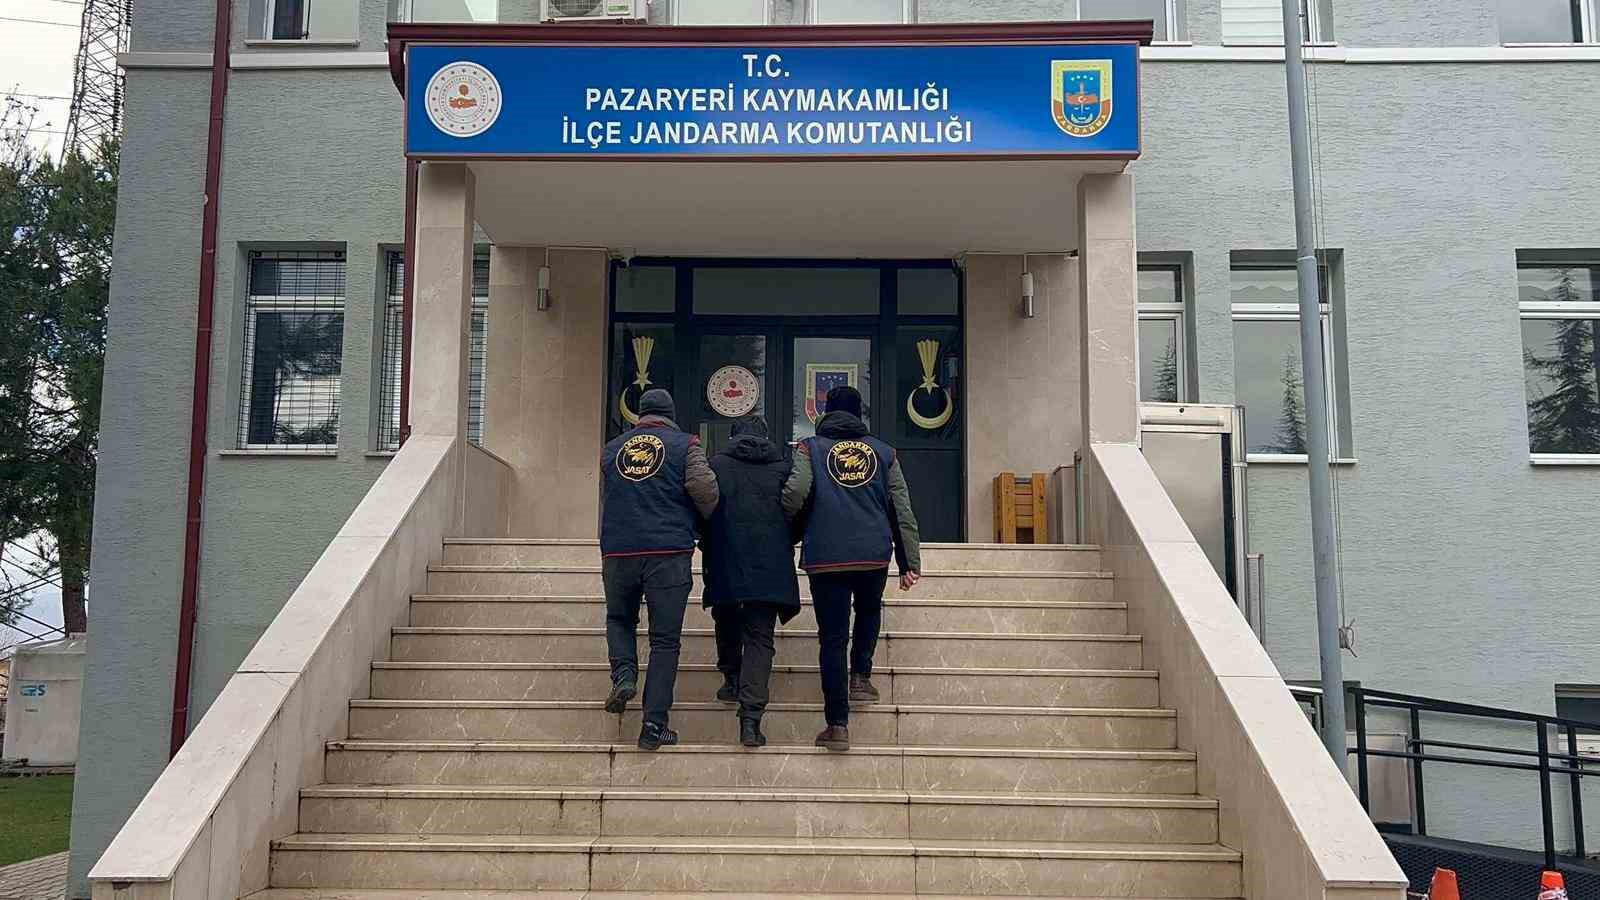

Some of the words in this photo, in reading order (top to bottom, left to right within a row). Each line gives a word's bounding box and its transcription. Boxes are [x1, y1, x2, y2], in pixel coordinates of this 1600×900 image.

[743, 54, 790, 77] T.C.
[586, 83, 733, 111] PAZARYERİ
[743, 82, 948, 111] KAYMAKAMLIĞI
[563, 116, 620, 148] İLÇE
[630, 122, 779, 144] JANDARMA
[787, 115, 972, 143] KOMUTANLIĞI
[624, 435, 663, 451] JANDARMA
[832, 441, 872, 457] JANDARMA
[625, 465, 651, 475] JASAT
[839, 472, 866, 481] JASAT
